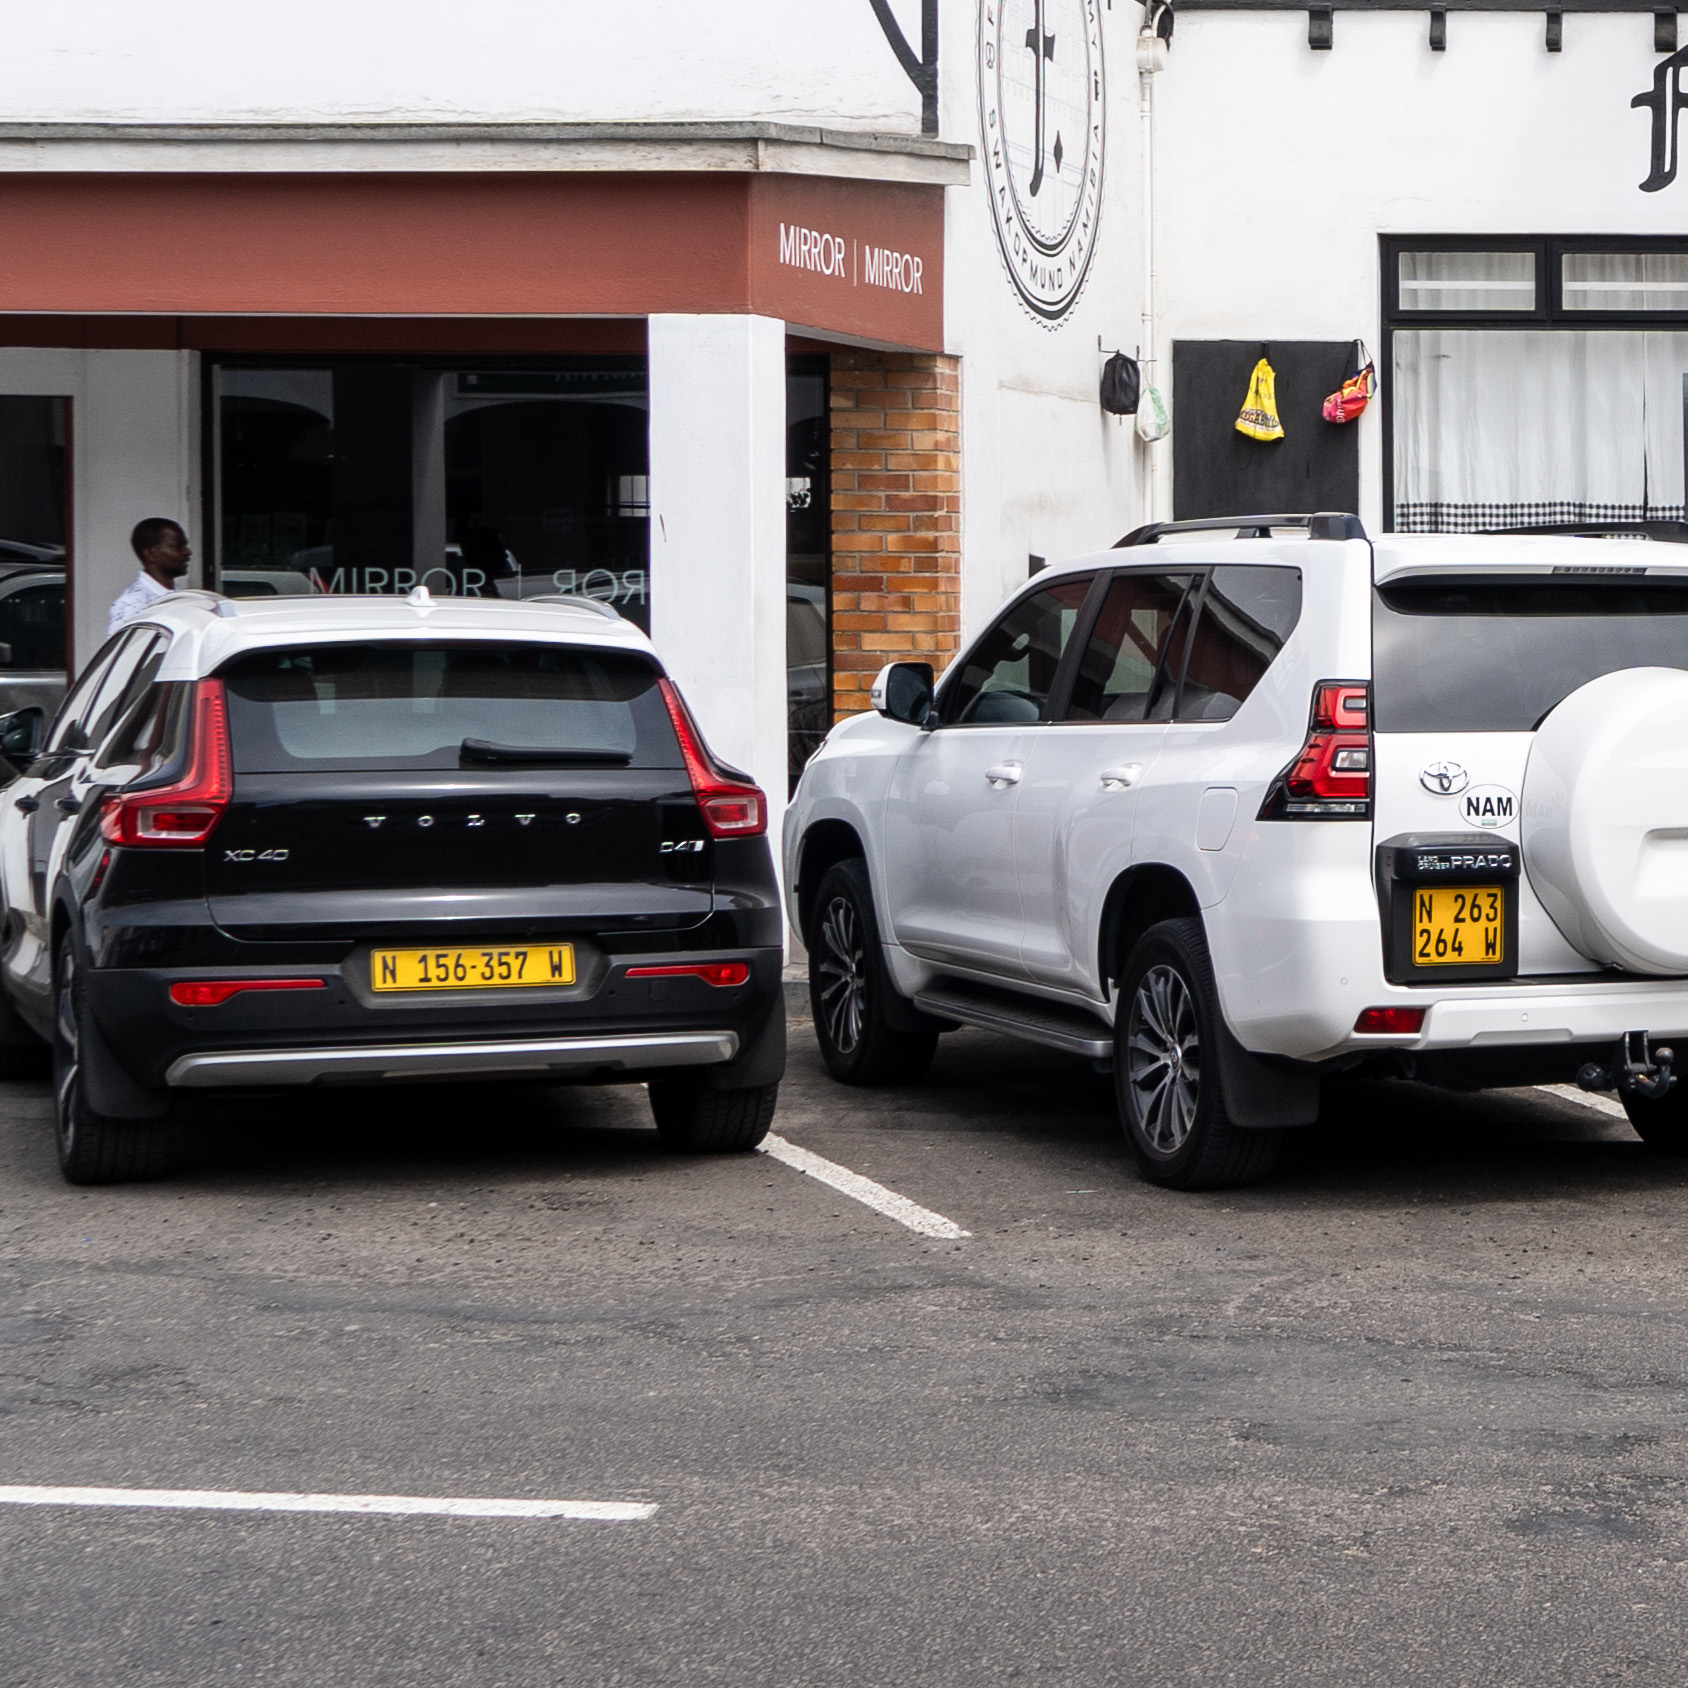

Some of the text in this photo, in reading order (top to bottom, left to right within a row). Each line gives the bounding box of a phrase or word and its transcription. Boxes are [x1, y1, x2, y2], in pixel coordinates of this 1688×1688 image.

[988, 108, 1100, 292] SWAKOPMUND NAMIBIA
[779, 222, 924, 295] MIRROR MIRROR
[308, 567, 487, 597] MIRROR
[363, 812, 582, 829] VOLVO
[1466, 796, 1513, 817] NAM
[1450, 854, 1513, 869] PRADO
[1419, 893, 1499, 924] N 263
[1418, 927, 1498, 958] 264 W
[381, 949, 563, 984] N 156-357 W
